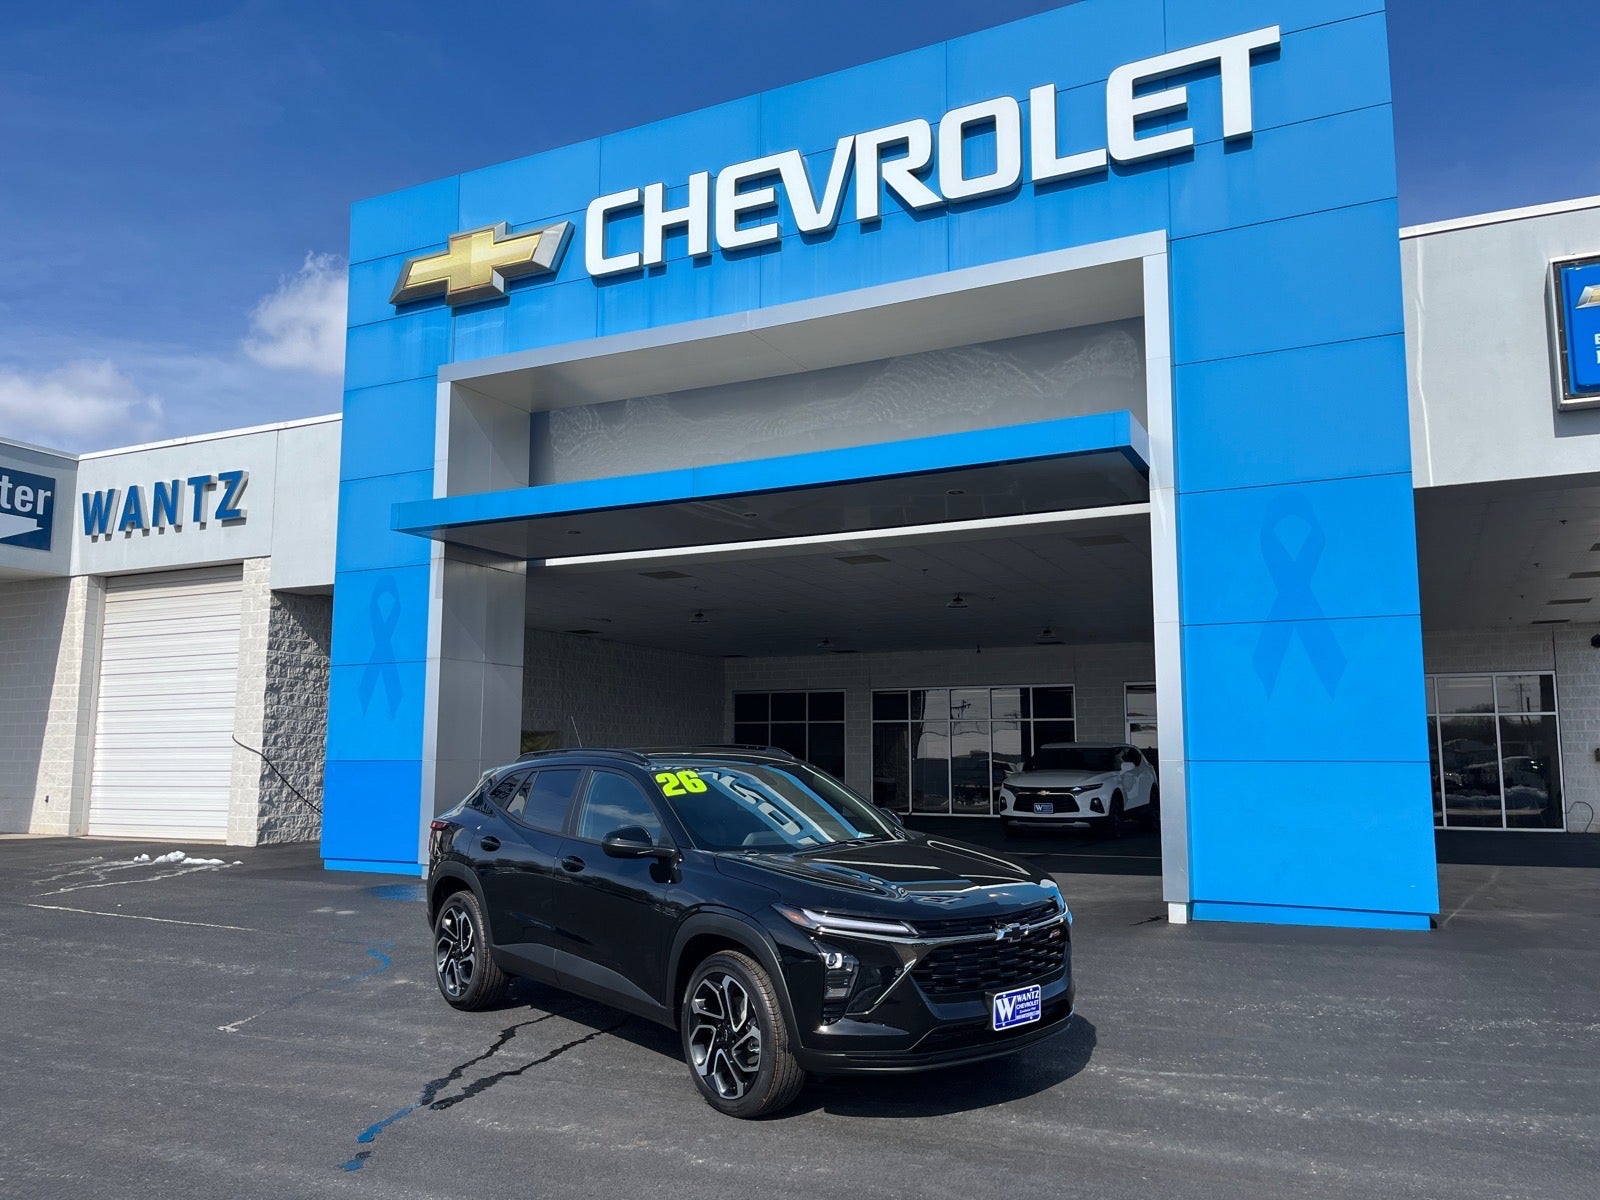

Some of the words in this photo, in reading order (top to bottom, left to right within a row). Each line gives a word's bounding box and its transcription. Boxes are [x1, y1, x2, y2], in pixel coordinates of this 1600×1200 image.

[585, 25, 1280, 277] CHEVROLET
[0, 474, 52, 515] ter
[82, 470, 247, 537] WANTZ
[655, 770, 708, 797] 26
[995, 995, 1017, 1022] W
[1016, 990, 1039, 1003] WANTZ
